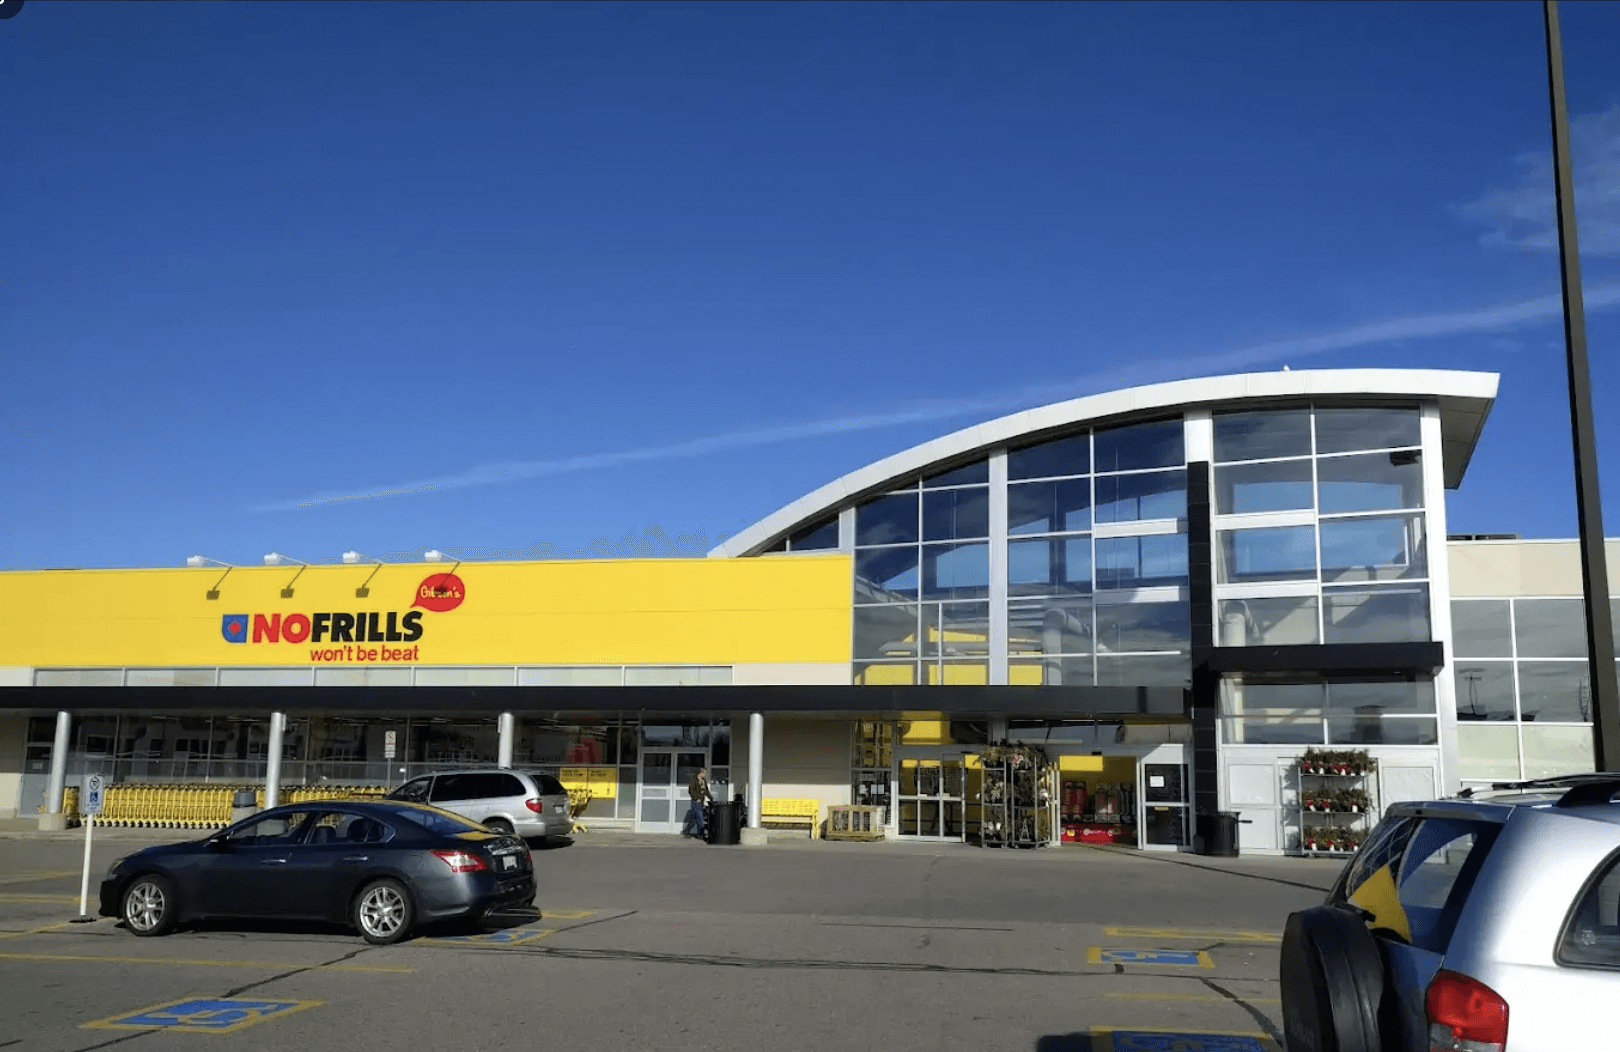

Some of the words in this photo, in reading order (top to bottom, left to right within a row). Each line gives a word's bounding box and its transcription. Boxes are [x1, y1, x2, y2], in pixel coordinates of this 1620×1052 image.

[310, 645, 354, 662] won't
[356, 645, 378, 662] be
[380, 644, 420, 662] beat
